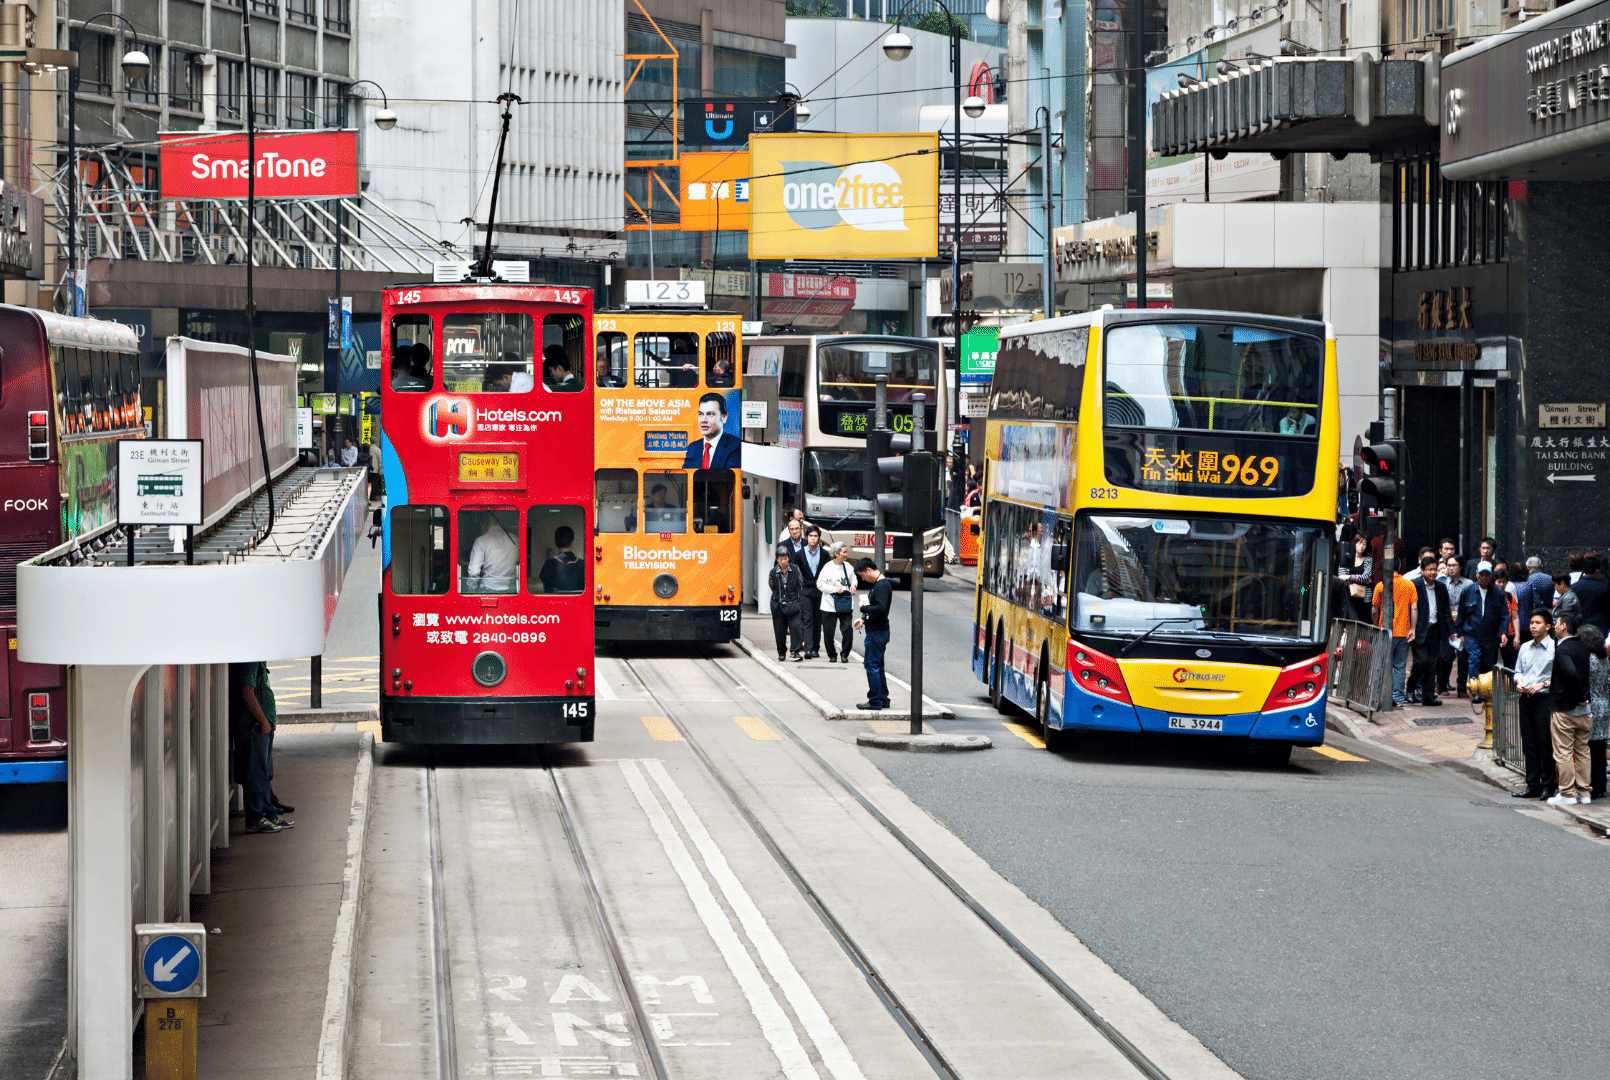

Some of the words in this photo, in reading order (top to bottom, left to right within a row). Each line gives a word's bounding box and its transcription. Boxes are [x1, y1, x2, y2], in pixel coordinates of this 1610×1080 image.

[191, 152, 326, 178] SmarTone
[783, 174, 904, 210] one2free
[646, 282, 690, 300] 123
[398, 290, 421, 305] 145
[555, 290, 580, 304] 145
[597, 320, 616, 331] 123
[716, 321, 735, 332] 123
[600, 399, 614, 407] ON
[616, 399, 635, 407] THE
[636, 399, 666, 407] MOVE
[667, 399, 691, 408] ASIA
[476, 408, 562, 422] Hotels.com
[600, 407, 614, 415] with
[615, 407, 646, 415] Rishaad
[648, 407, 681, 415] Salamat
[600, 415, 628, 423] Weekdays
[1550, 415, 1596, 425] 機利文街
[669, 432, 687, 440] Market
[130, 450, 144, 460] 23E
[461, 456, 500, 466] Causeway
[503, 455, 517, 466] Bay
[1144, 448, 1219, 471] 天水圍
[1535, 451, 1551, 459] TAI
[1553, 451, 1579, 459] SANG
[1581, 451, 1606, 459] BANK
[1222, 454, 1279, 487] 969
[1548, 462, 1594, 471] BUILDING
[1141, 466, 1161, 481] Tin
[1165, 468, 1193, 483] Shui
[1197, 469, 1221, 484] Wai
[1090, 488, 1118, 499] 8213
[4, 498, 48, 511] FOOK
[623, 545, 708, 564] Bloomberg
[624, 561, 676, 570] TELEVISION
[445, 613, 560, 625] www.hotels.com
[720, 609, 738, 622] 123
[426, 630, 468, 644] 或致電
[473, 632, 547, 644] 2840-0896
[1180, 672, 1211, 681] CITYBUS
[563, 702, 588, 718] 145
[1171, 718, 1185, 728] RL
[1191, 719, 1220, 730] 3944
[167, 1008, 176, 1018] B
[159, 1021, 182, 1031] 278
